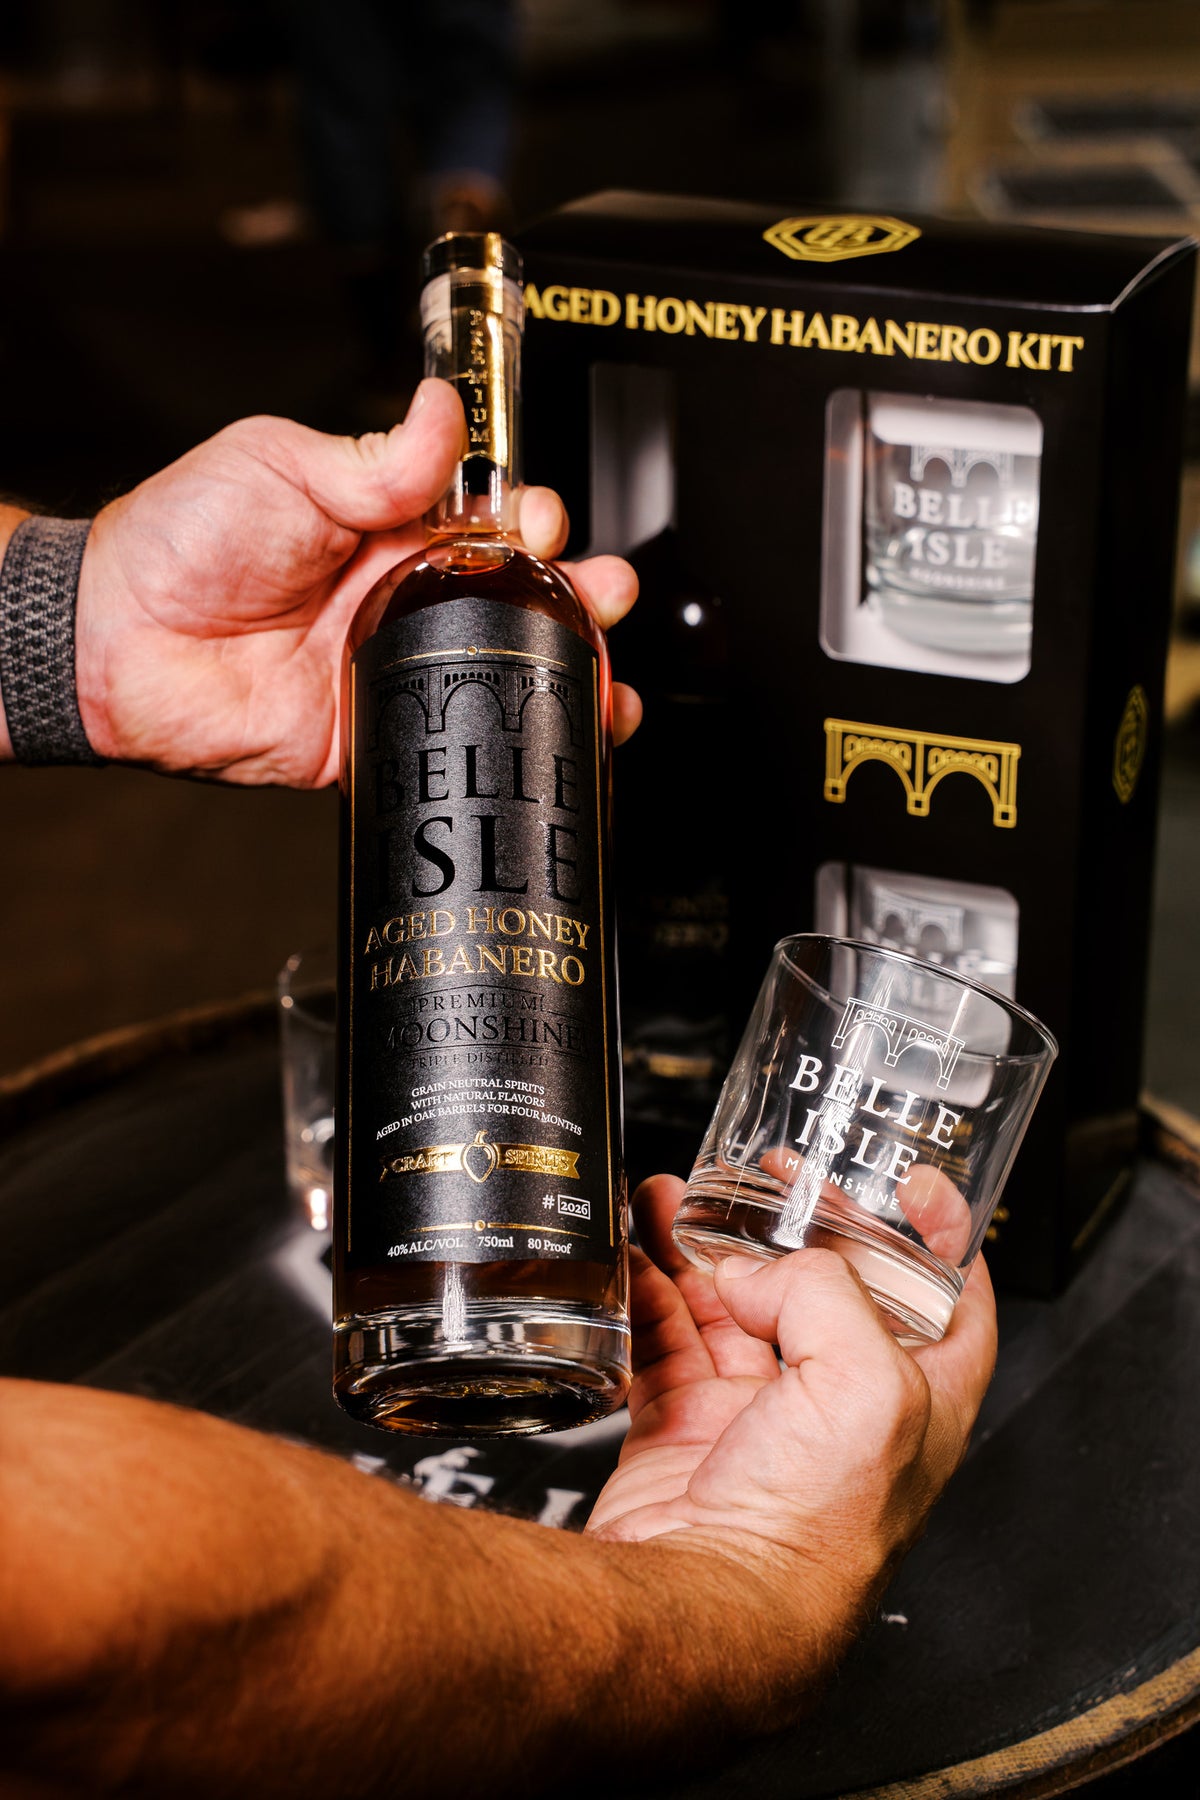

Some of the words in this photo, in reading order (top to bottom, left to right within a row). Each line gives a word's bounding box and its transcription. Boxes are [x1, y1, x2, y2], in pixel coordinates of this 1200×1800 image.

[523, 283, 621, 326] AGED
[626, 294, 767, 342] HONEY
[771, 311, 1001, 366] HABANERO
[1005, 331, 1085, 373] KIT
[907, 528, 1010, 570] ISLE
[373, 744, 581, 816] BELLE
[375, 814, 581, 906] ISLE
[364, 909, 456, 955] AGED
[466, 906, 591, 950] HONEY
[370, 944, 586, 991] HABANERO
[418, 993, 537, 1011] PREMIUM
[411, 1080, 446, 1098] GRAIN
[449, 1078, 503, 1090] NEUTRAL
[505, 1079, 545, 1095] SPIRITS
[411, 1095, 442, 1111] WITH
[443, 1091, 497, 1103] NATURAL
[498, 1091, 546, 1108] FLAVORS
[789, 1054, 962, 1150] BELLE
[376, 1122, 401, 1140] AGED
[401, 1115, 413, 1127] IN
[414, 1110, 437, 1124] OAK
[438, 1104, 486, 1118] BARRELS
[487, 1104, 511, 1116] FOR
[511, 1106, 540, 1120] FOUR
[541, 1112, 583, 1136] MONTHS
[392, 1151, 451, 1172] CRAFT
[505, 1149, 570, 1171] SPIRITS
[795, 1108, 920, 1186] ISLE
[542, 1194, 555, 1210] #
[560, 1201, 588, 1216] 2026
[785, 1157, 901, 1212] MOONSHINE
[409, 1236, 464, 1254] ALC/VOL
[478, 1235, 514, 1248] 750ml
[527, 1238, 542, 1250] 80
[544, 1239, 572, 1255] Proof
